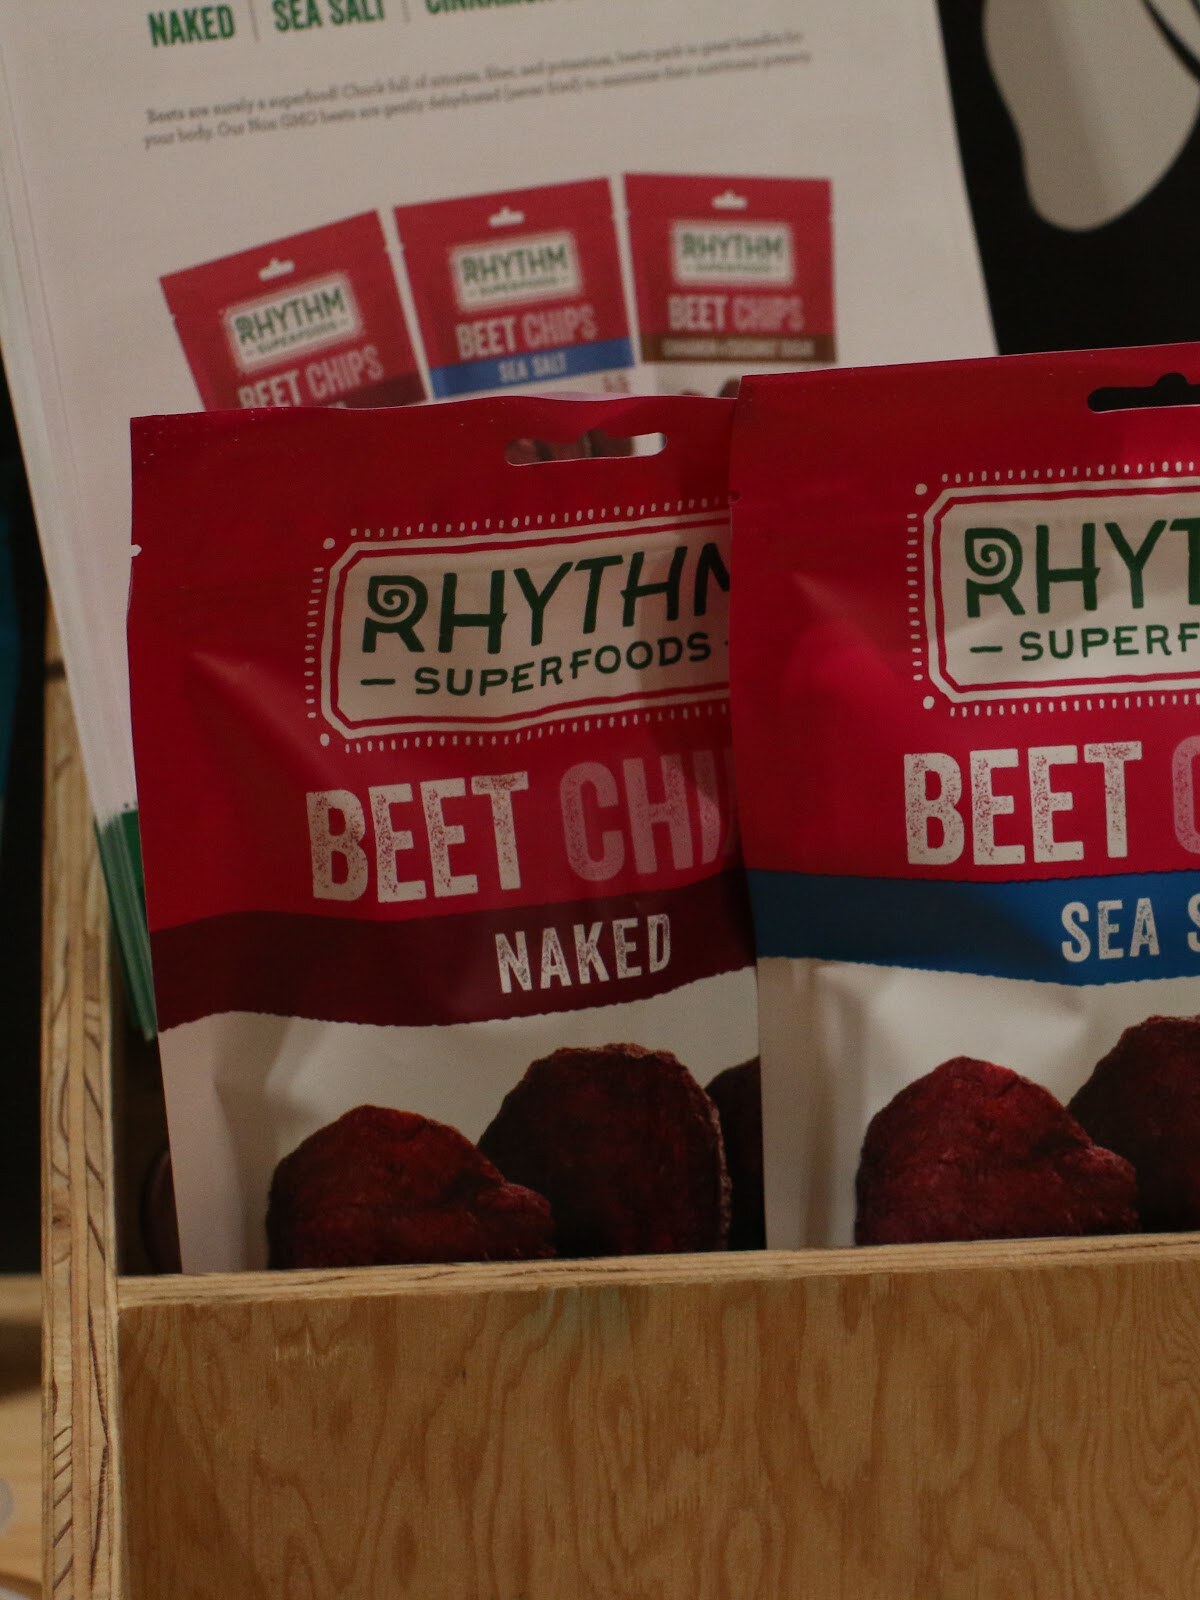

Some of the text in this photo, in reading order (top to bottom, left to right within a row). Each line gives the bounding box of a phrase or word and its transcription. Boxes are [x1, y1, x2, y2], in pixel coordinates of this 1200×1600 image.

[148, 5, 236, 47] NAKED
[272, 0, 323, 33] SEA
[461, 244, 567, 284] RHYTHM
[682, 232, 783, 260] RHYTHM
[235, 286, 346, 344] RHYTHM
[456, 303, 597, 360] BEET CHIPS
[667, 295, 806, 331] BEET CHIPS
[238, 345, 385, 408] BEET CHIPS
[498, 352, 567, 382] SEA SALT
[414, 631, 712, 697] SUPERFOODS
[306, 749, 738, 903] BEET CHI
[903, 740, 1143, 866] BEET
[495, 914, 673, 995] NAKED
[1060, 898, 1161, 963] SEA
